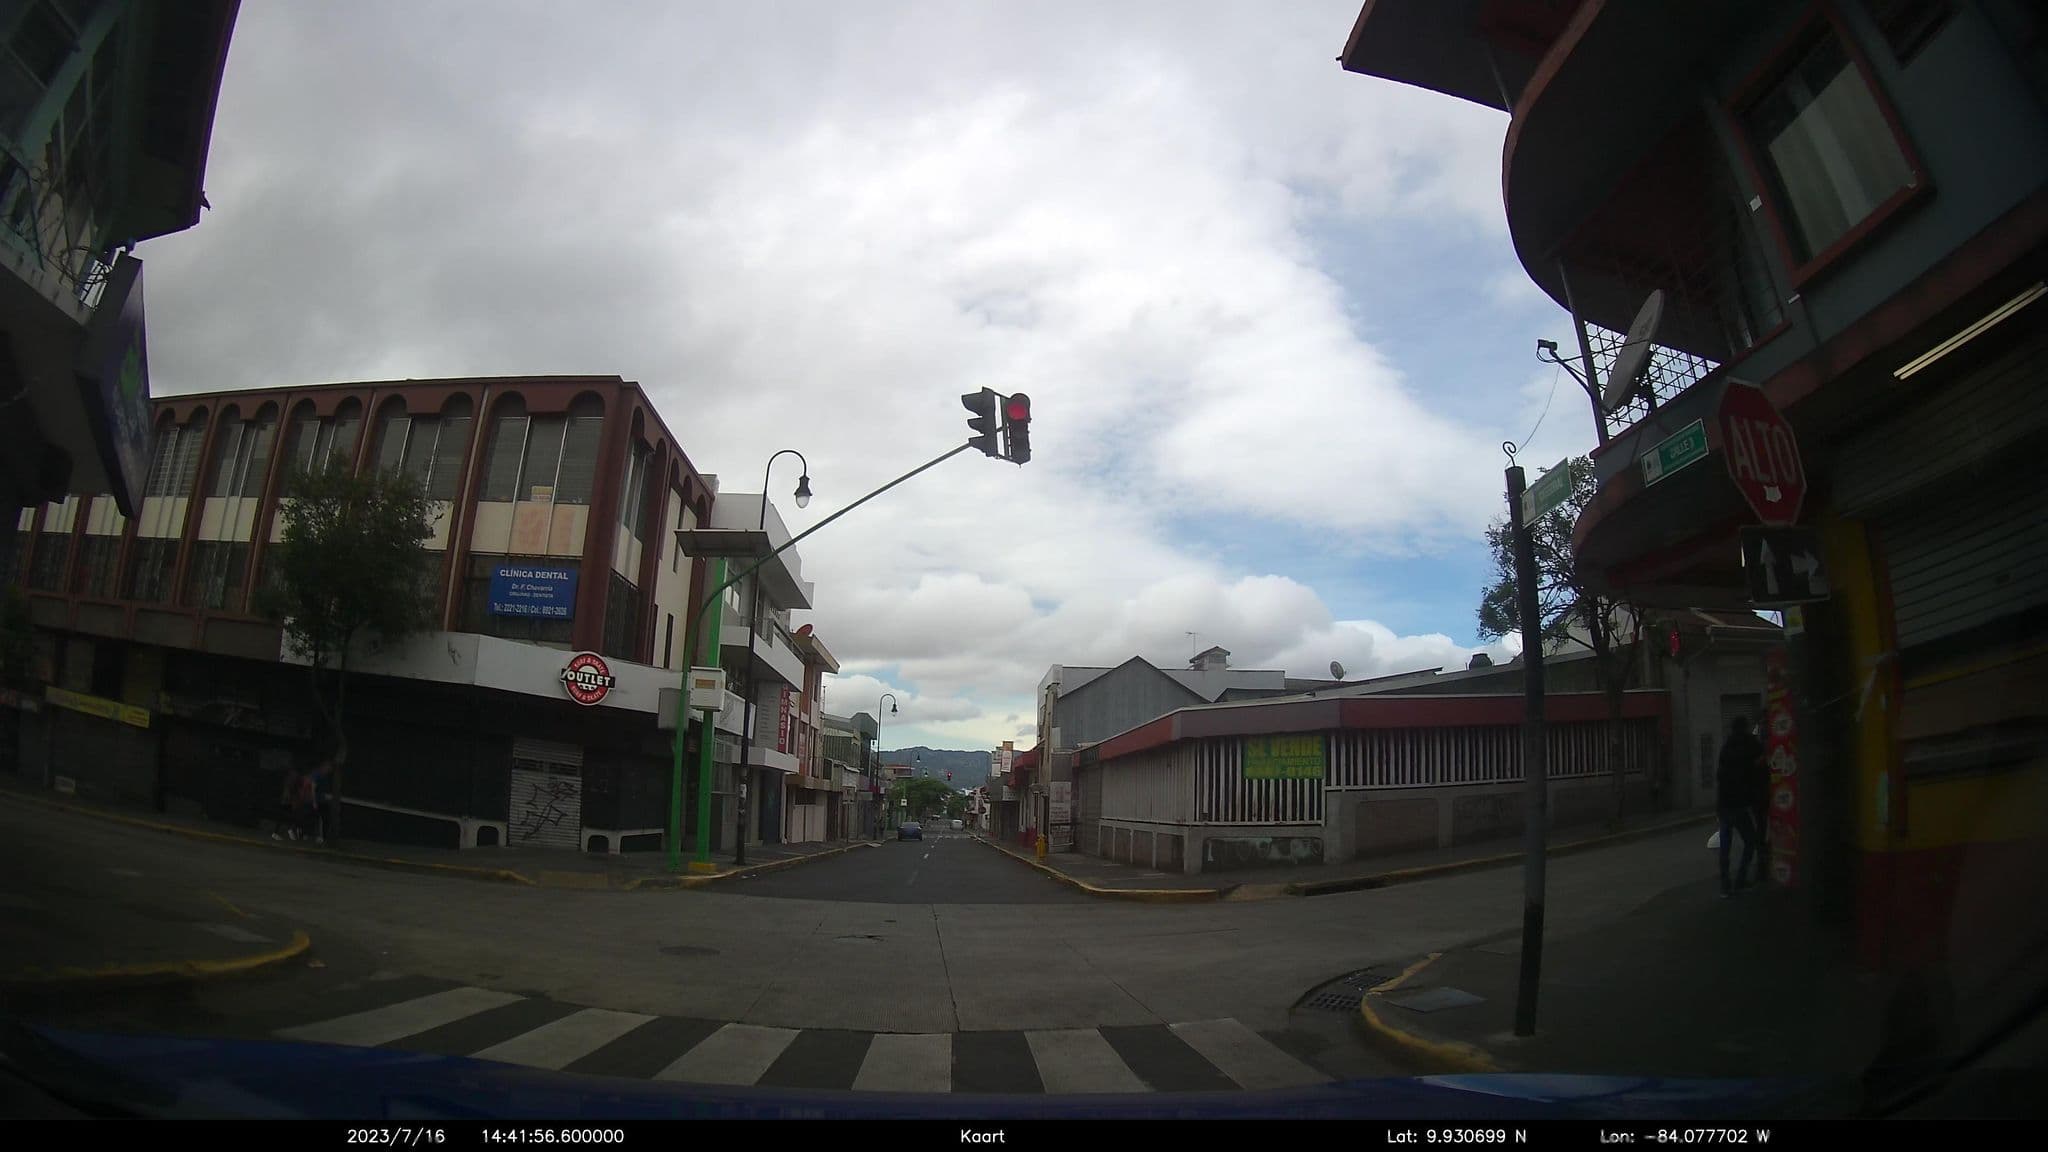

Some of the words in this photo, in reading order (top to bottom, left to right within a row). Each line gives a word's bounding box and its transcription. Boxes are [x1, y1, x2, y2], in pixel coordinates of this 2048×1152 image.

[1670, 439, 1690, 459] CALLE
[1729, 415, 1796, 484] ALTO
[500, 568, 533, 578] CLÍNICA
[535, 571, 569, 580] DENTAL
[567, 670, 611, 687] OUTLET
[1271, 736, 1321, 756] VENDE
